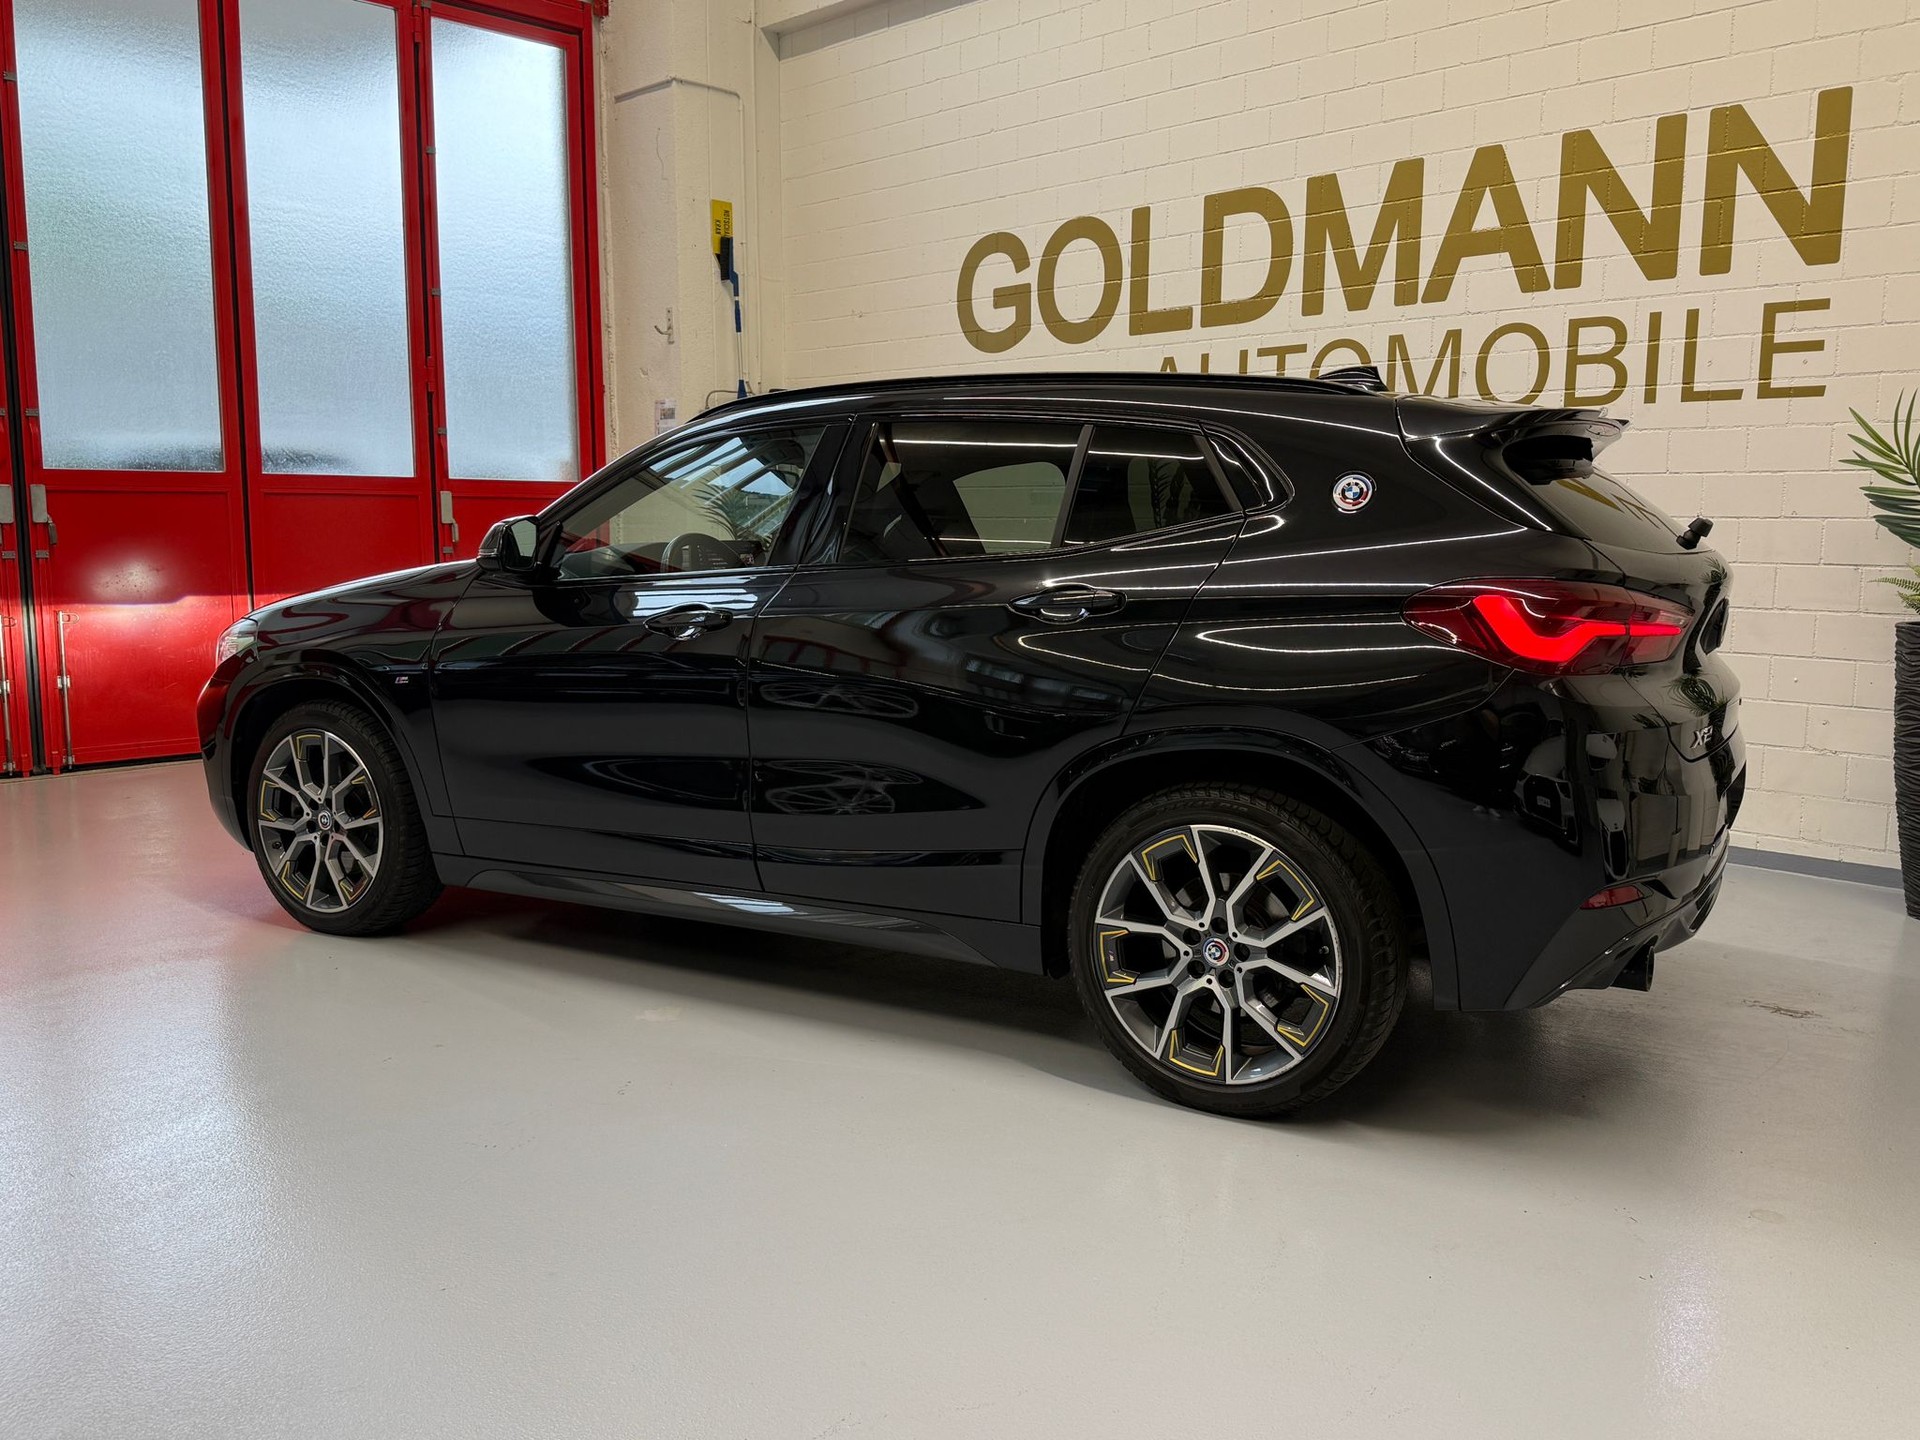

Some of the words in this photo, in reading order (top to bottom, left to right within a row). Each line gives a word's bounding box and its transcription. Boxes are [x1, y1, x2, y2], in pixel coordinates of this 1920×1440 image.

[957, 87, 1853, 352] GOLDMANN
[1159, 298, 1831, 408] TMOBILE
[1690, 725, 1713, 748] X2
